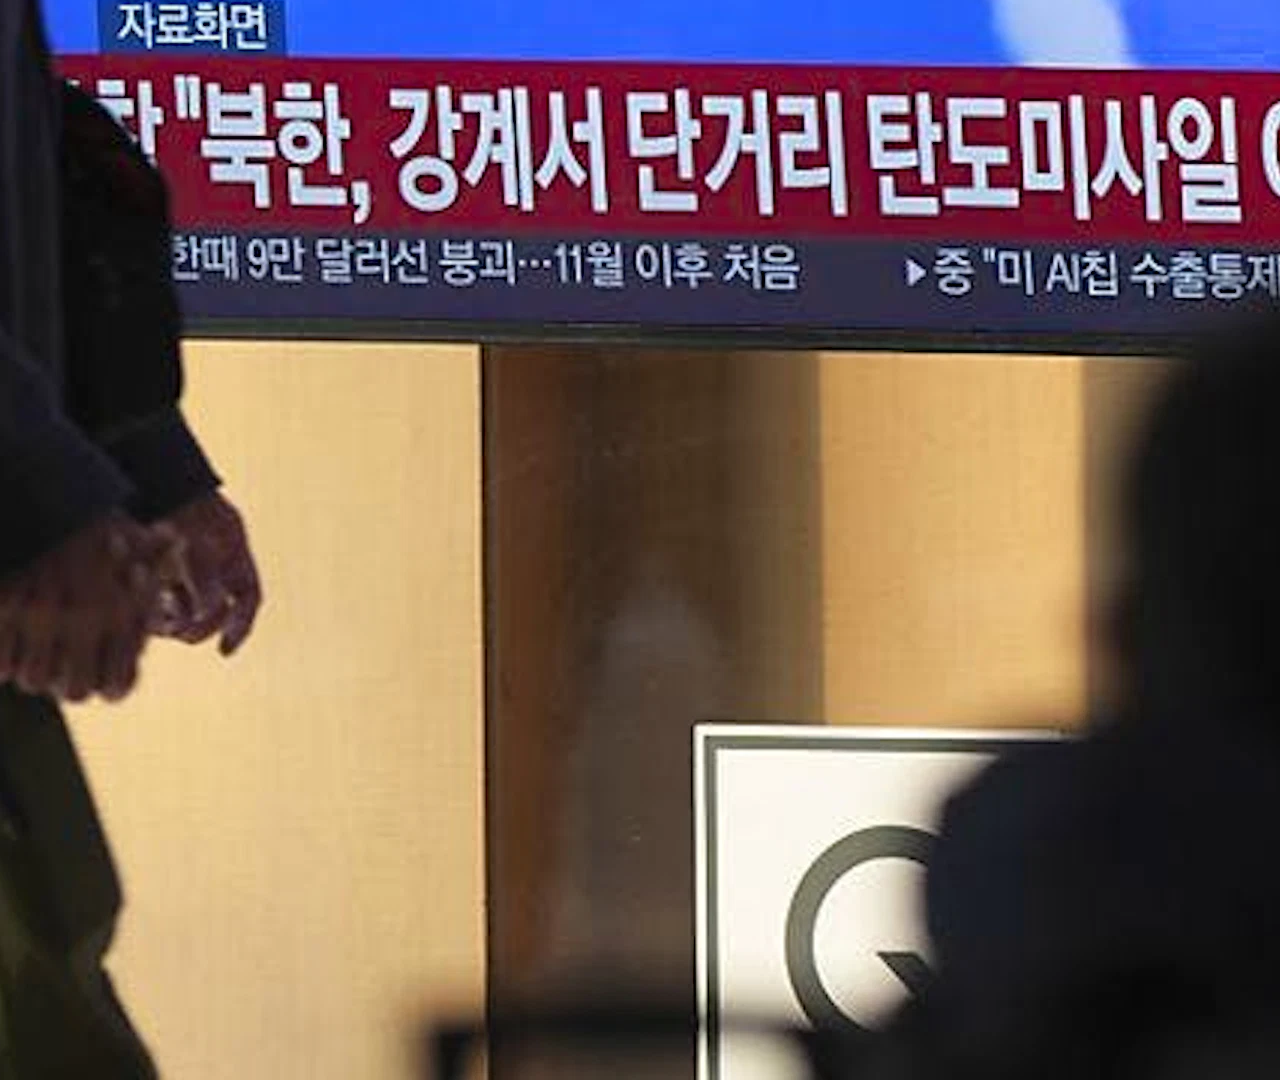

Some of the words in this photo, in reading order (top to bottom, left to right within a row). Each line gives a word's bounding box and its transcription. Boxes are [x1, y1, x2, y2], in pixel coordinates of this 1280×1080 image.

[117, 1, 268, 51] 자료화면
[173, 74, 372, 225] "북한,
[388, 85, 609, 214] 강계서
[626, 88, 849, 218] 단거리
[866, 91, 1243, 224] 탄도미사일
[172, 235, 239, 281] 한때
[246, 238, 306, 282] 9만
[315, 238, 429, 284] 달러선
[635, 242, 714, 290] 이후
[723, 243, 802, 291] 처음
[933, 246, 975, 297] 중
[1046, 250, 1119, 297] AI칩
